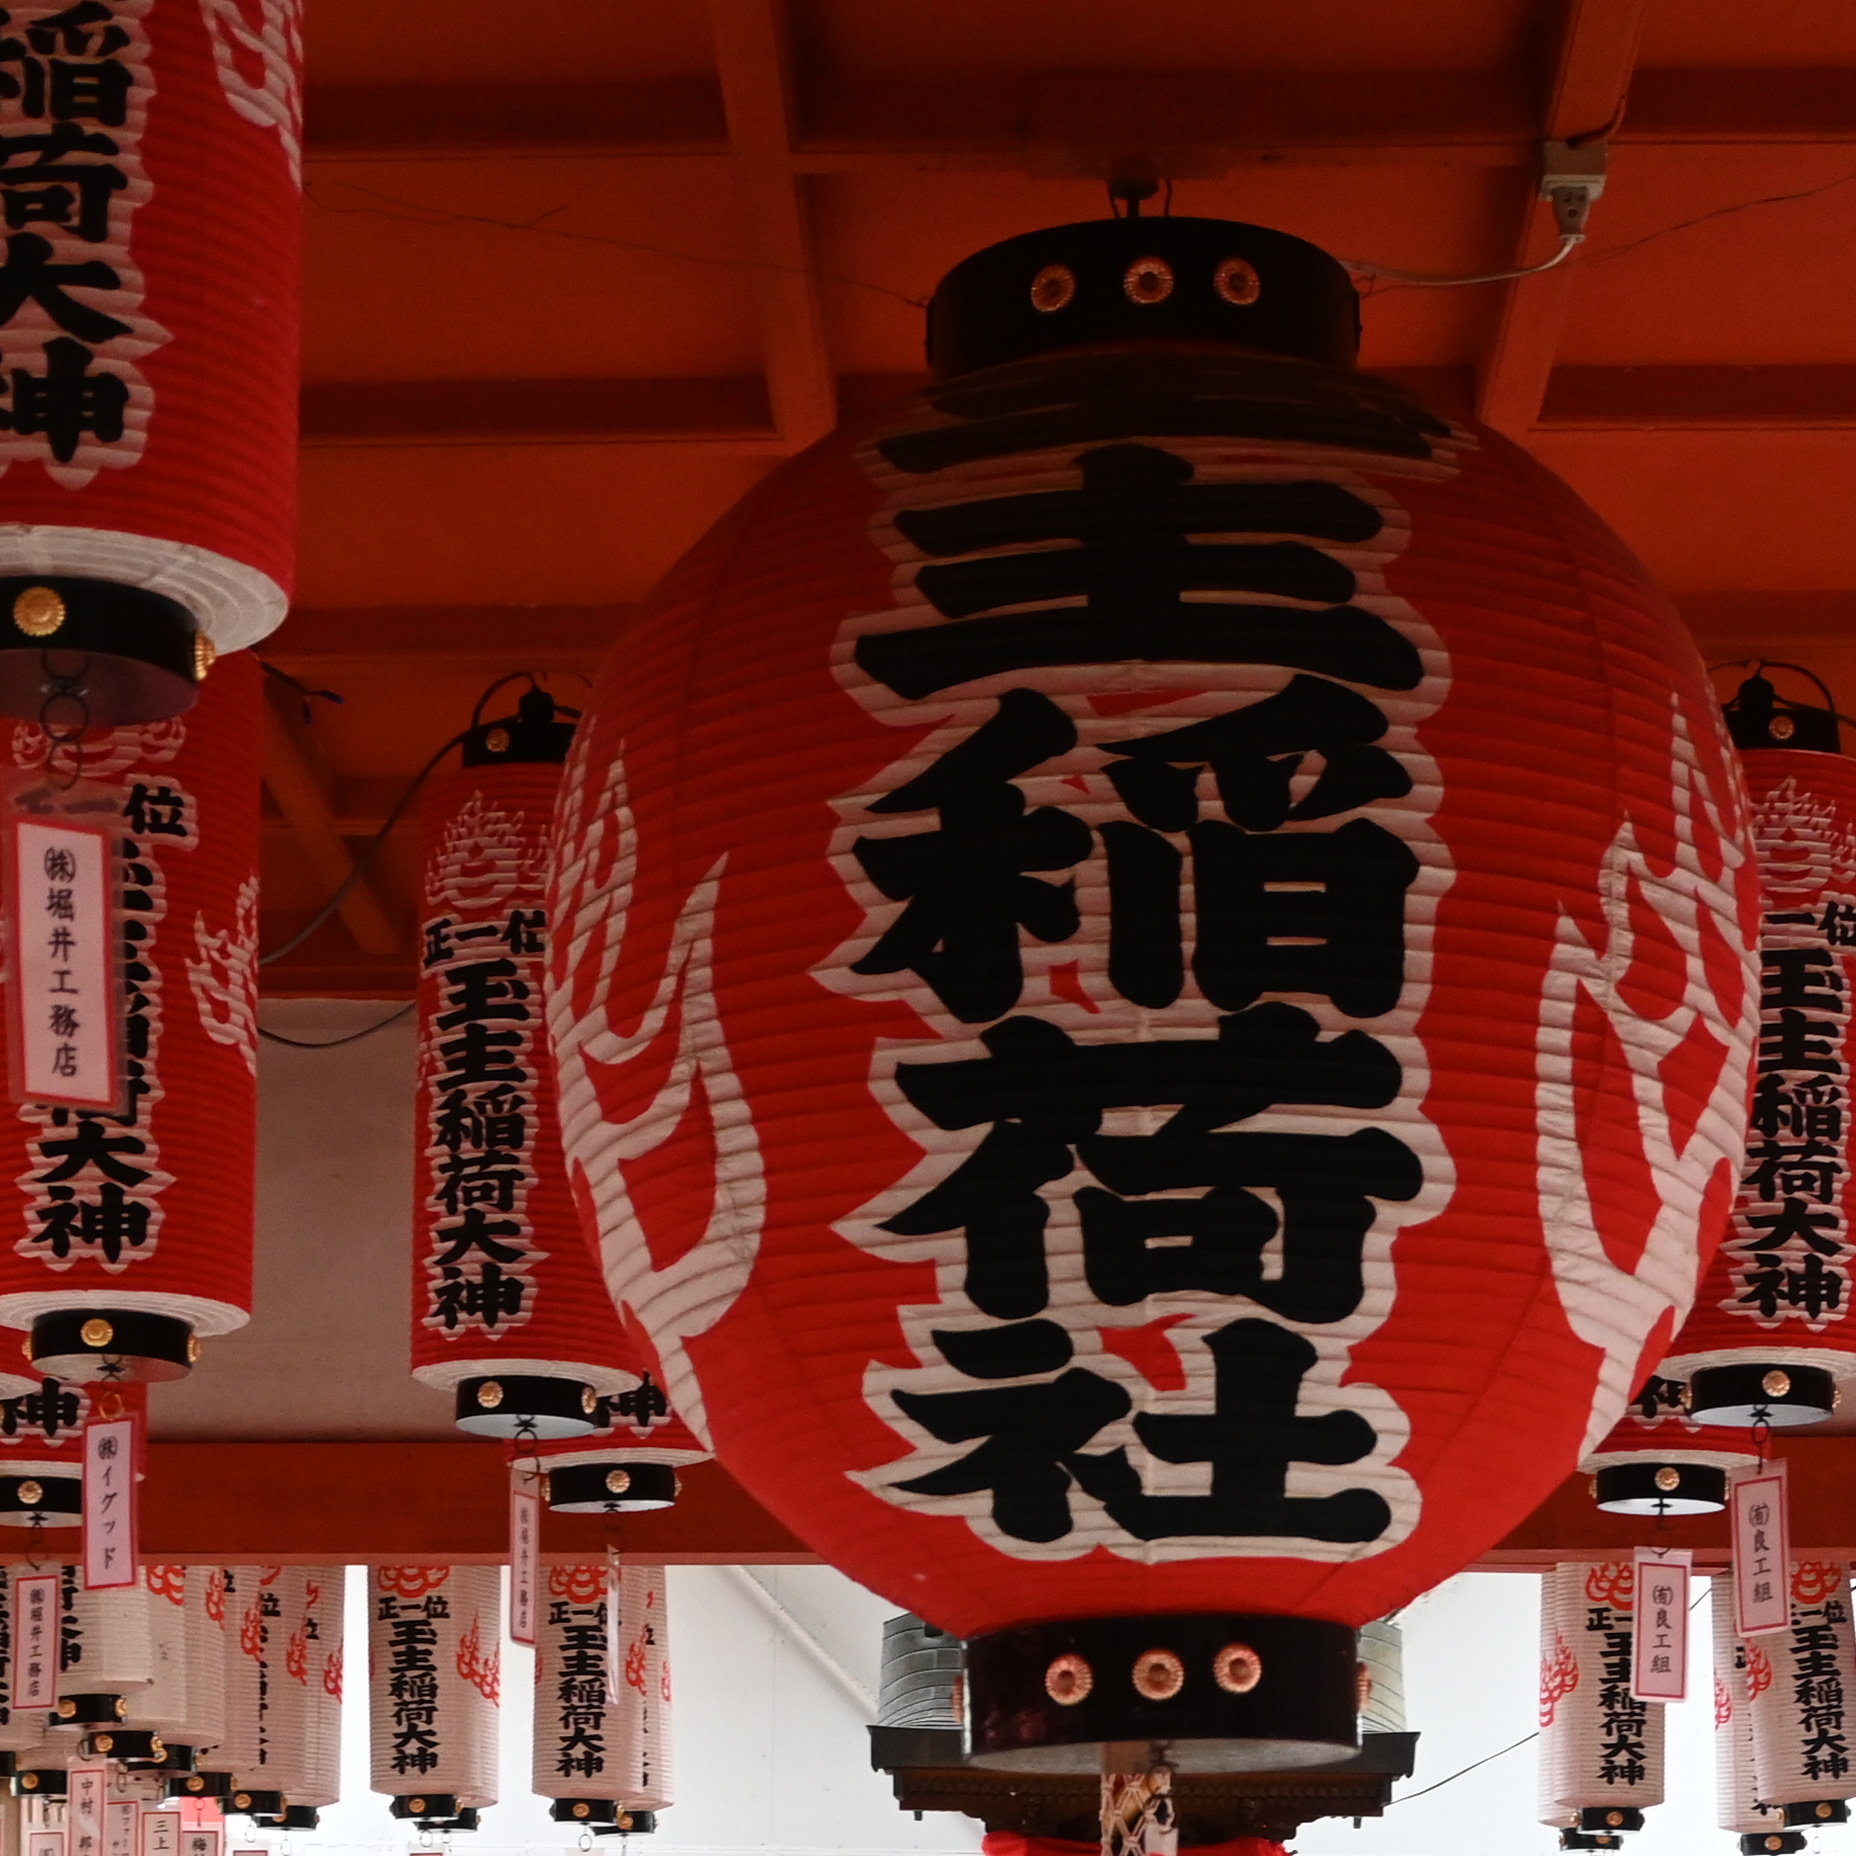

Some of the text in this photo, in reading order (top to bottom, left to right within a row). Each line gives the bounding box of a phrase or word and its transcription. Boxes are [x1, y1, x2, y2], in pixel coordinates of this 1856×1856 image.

[435, 963, 529, 1330] 玉主稲荷大神
[389, 1620, 440, 1774] 玉主稲荷大神
[557, 1626, 608, 1777] 玉主稲荷大神
[1790, 1627, 1850, 1783] 玉主稲荷大神
